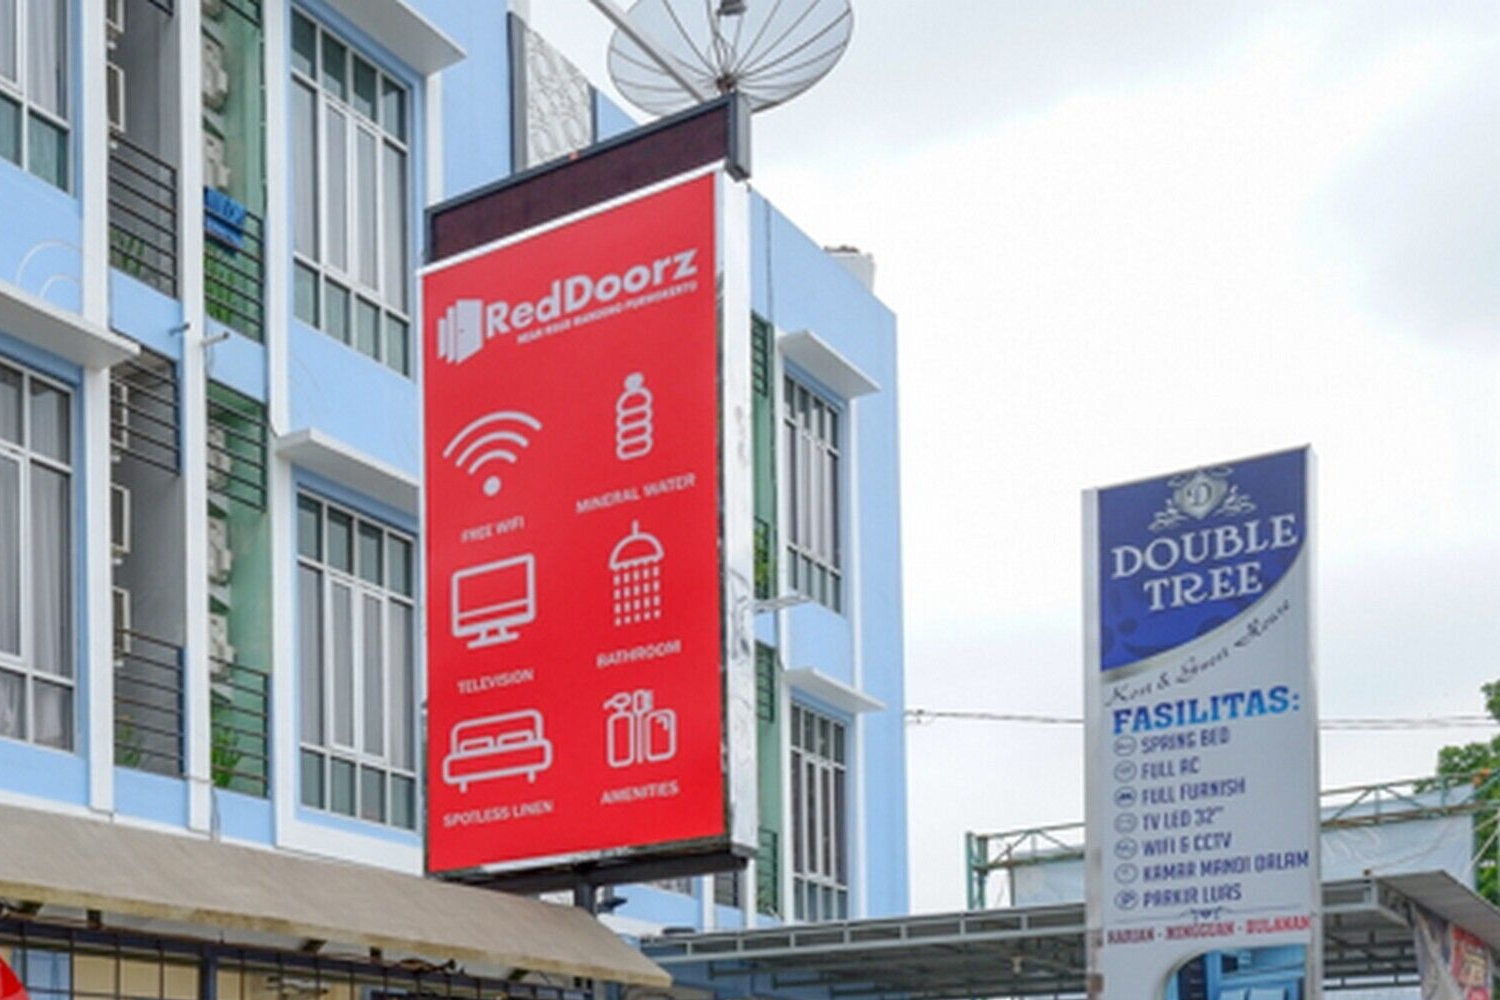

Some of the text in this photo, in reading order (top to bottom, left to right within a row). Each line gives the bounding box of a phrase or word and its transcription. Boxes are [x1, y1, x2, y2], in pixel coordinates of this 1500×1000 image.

[486, 249, 697, 339] RedDoorz
[576, 473, 696, 513] MINERAL WATER
[461, 517, 525, 543] FREE WIFI
[1111, 514, 1298, 580] DOUBLE
[1144, 562, 1263, 611] TREE
[597, 640, 682, 668] BATHROOM
[458, 669, 534, 694] TELEVISION
[1113, 685, 1300, 735] FASILITAS:
[1142, 726, 1231, 754] SPRING BED
[1141, 756, 1200, 780] FULL AC
[601, 780, 679, 805] AMENITIES
[1142, 777, 1246, 805] FULL FURNISH
[443, 801, 554, 828] SPOTLESS LINEN
[1143, 812, 1160, 831] TV
[1164, 809, 1191, 829] LED
[1143, 838, 1176, 856] WIFI
[1194, 832, 1232, 851] CCTV
[1143, 851, 1310, 881] KAMAR MANDI DALAM
[1143, 882, 1242, 907] PARKIR LUAS
